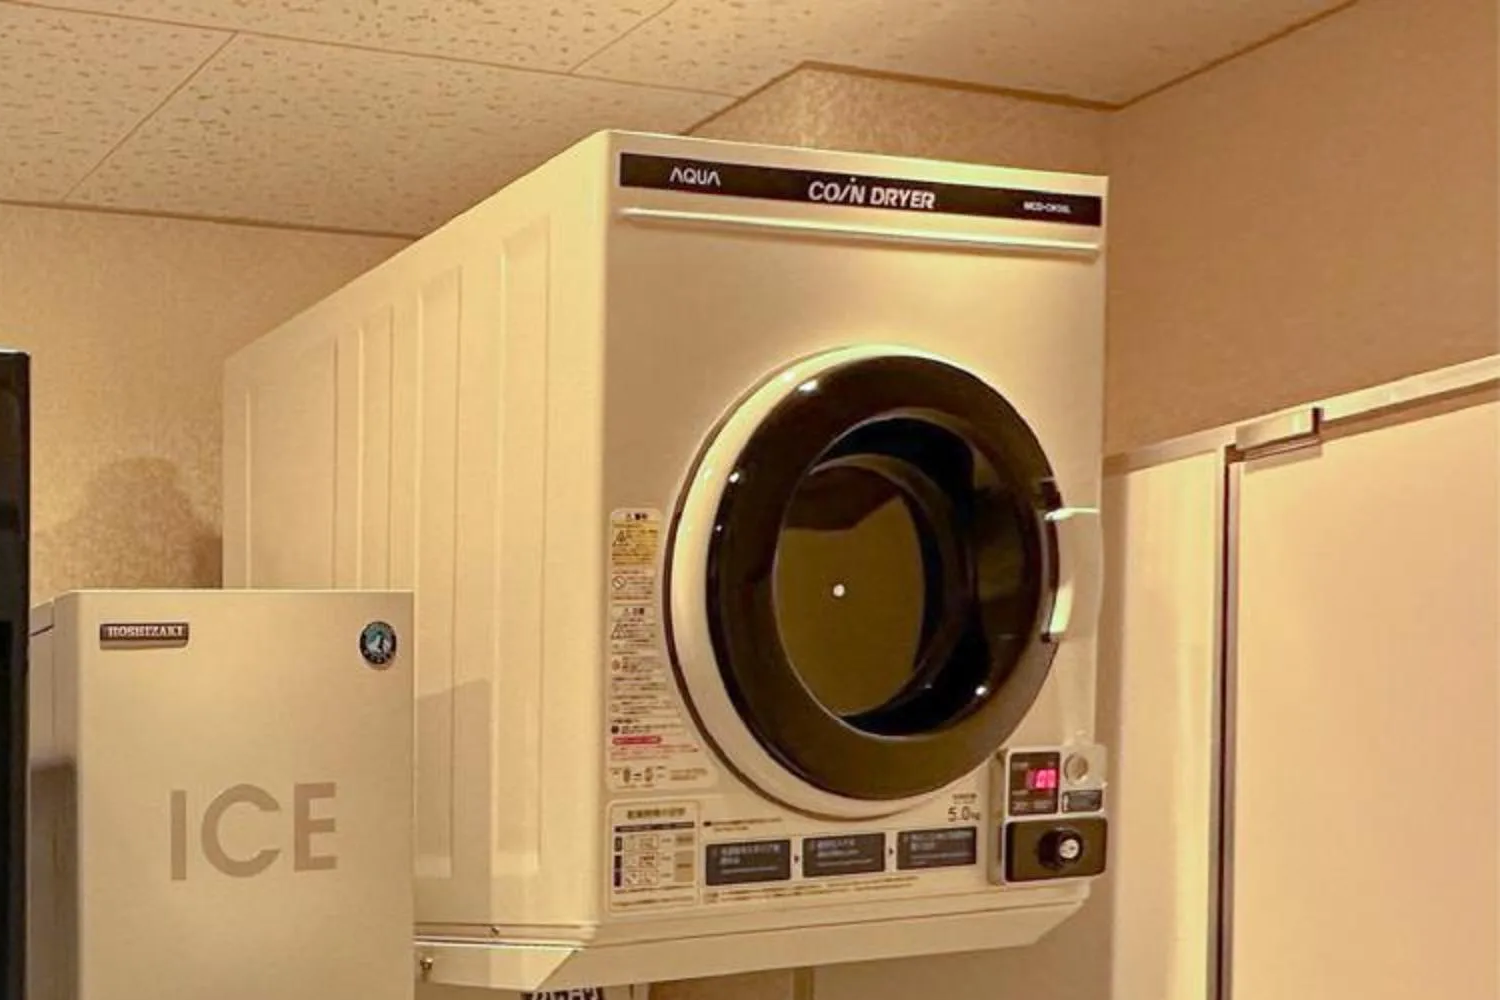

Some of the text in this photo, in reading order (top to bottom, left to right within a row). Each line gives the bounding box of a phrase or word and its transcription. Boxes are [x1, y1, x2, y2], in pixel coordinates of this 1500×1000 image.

[669, 166, 721, 186] AQUA
[870, 188, 936, 210] DRYER
[108, 625, 183, 637] HOSHIZAKI
[171, 783, 338, 881] ICE
